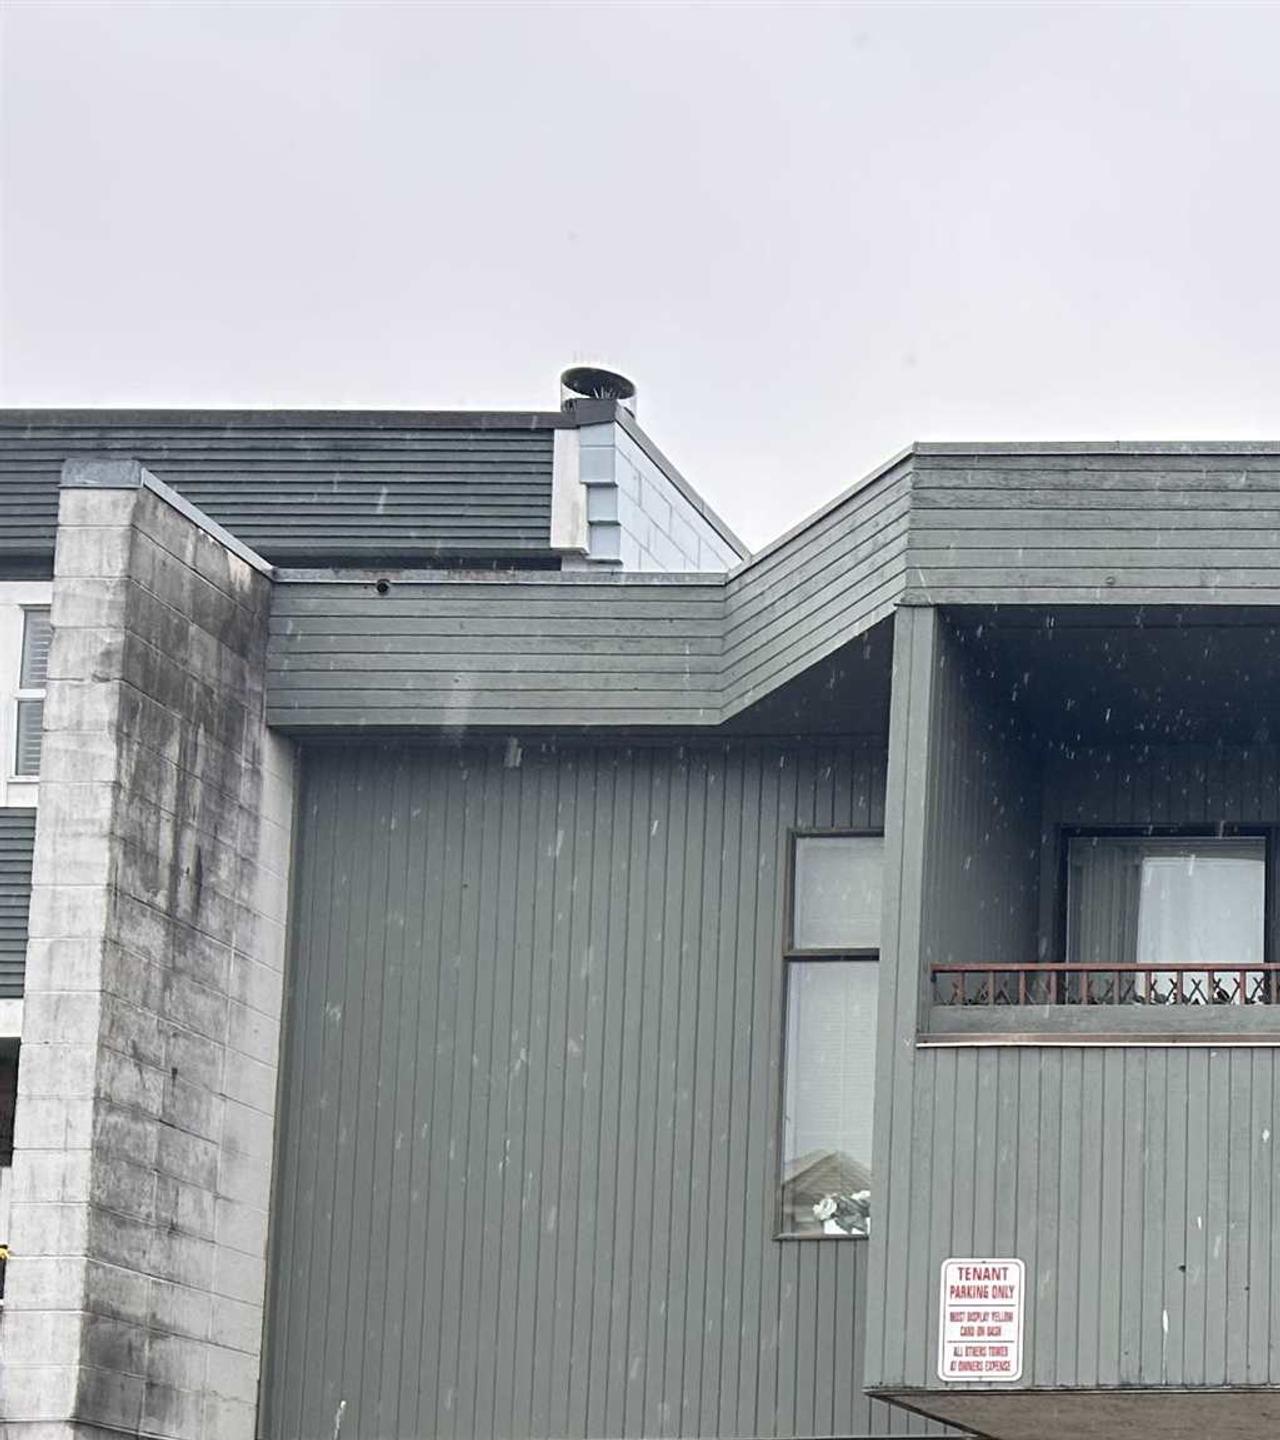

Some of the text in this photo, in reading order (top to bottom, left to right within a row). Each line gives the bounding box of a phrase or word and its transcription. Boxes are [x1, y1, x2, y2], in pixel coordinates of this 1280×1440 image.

[957, 1266, 1009, 1281] TENANT
[949, 1284, 1015, 1299] PARKING ONLY
